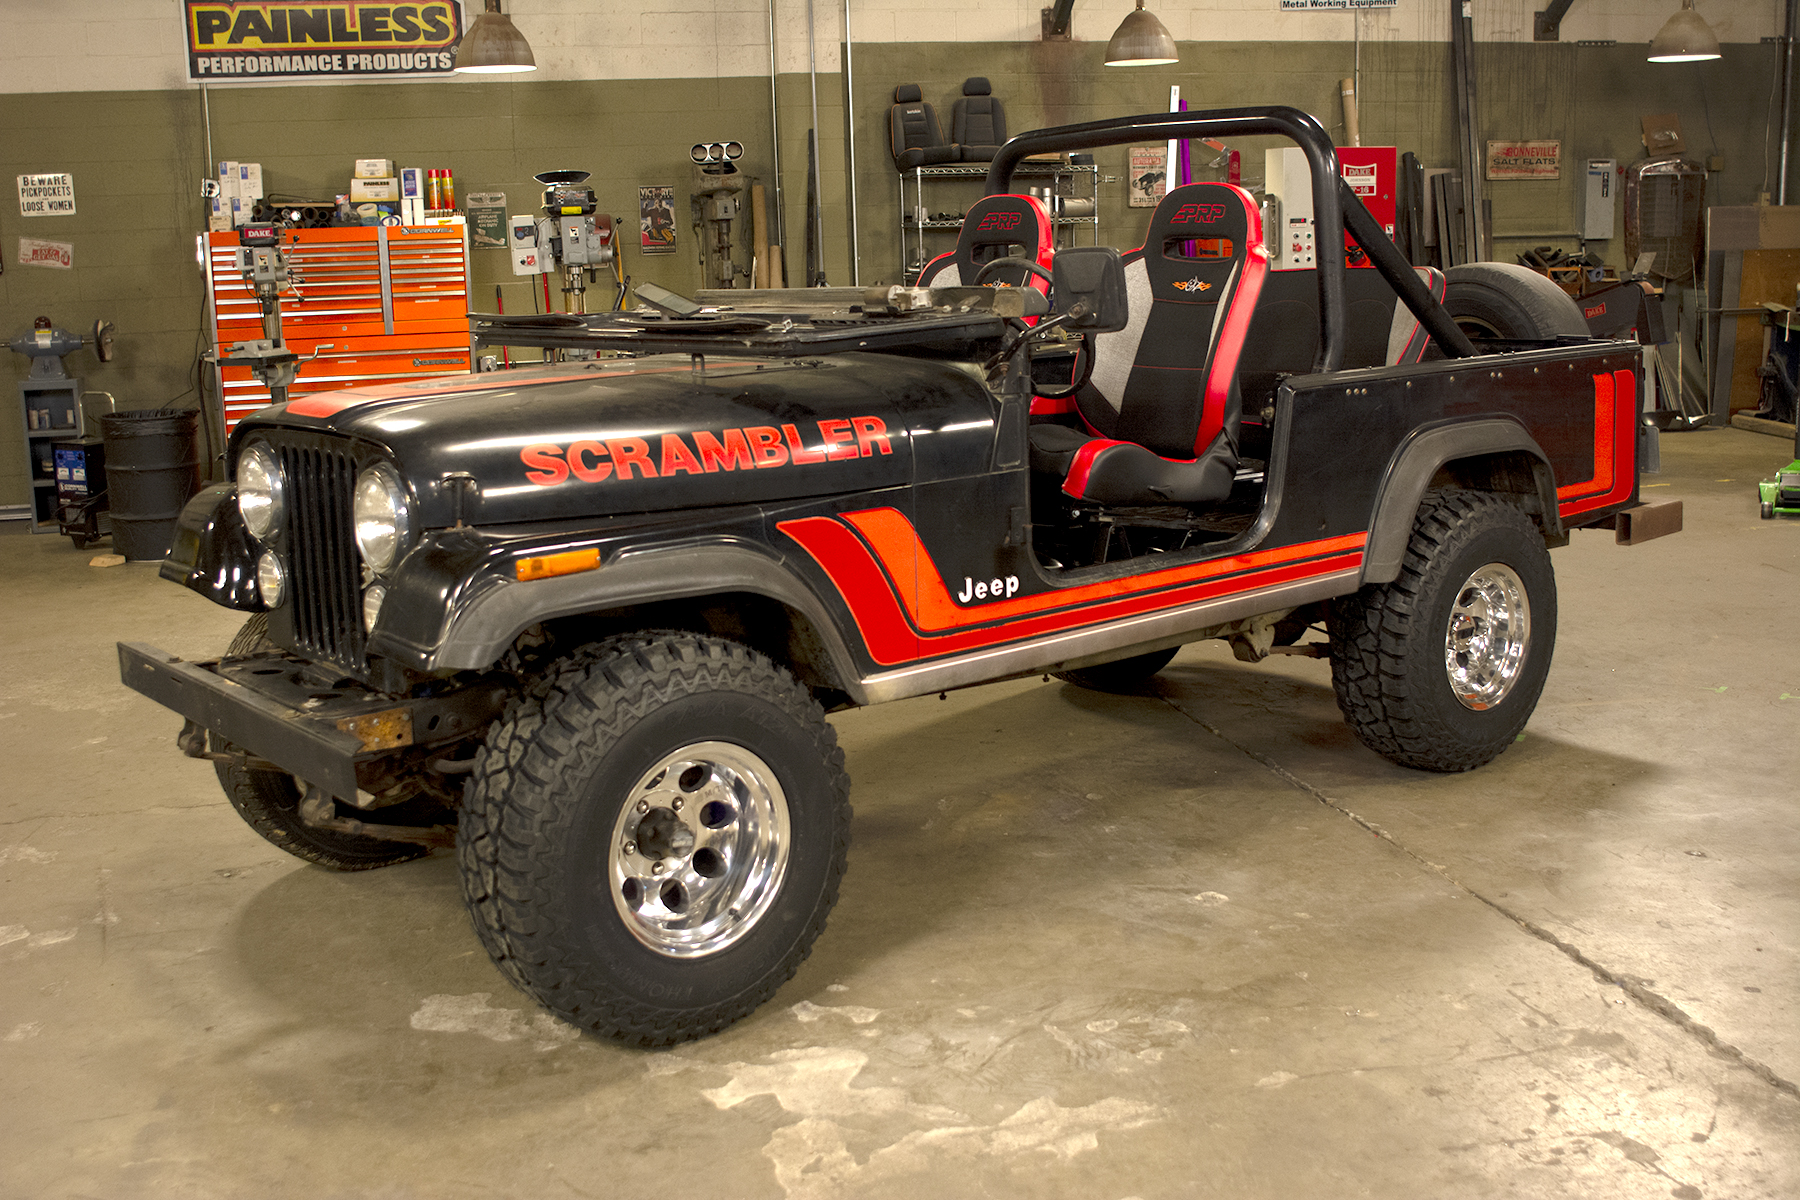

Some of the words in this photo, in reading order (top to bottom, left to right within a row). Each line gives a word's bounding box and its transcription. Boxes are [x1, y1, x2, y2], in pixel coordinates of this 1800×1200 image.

[1310, 0, 1346, 8] Working
[1350, 0, 1396, 8] Equipment
[196, 6, 451, 45] PAINLESS
[197, 55, 343, 74] PERFORMANCE
[347, 52, 453, 71] PRODUCTS
[1507, 147, 1557, 157] BONNEVILLE
[1349, 168, 1371, 176] DAKE
[23, 175, 67, 186] BEWARE
[21, 186, 71, 198] PICKPOCKETS
[22, 202, 45, 212] LOOSE
[48, 200, 74, 211] WOMEN
[1170, 204, 1226, 223] PRP
[977, 212, 1022, 230] PRP
[248, 230, 271, 238] DAKE
[520, 416, 893, 486] SCRAMBLER
[957, 575, 1020, 603] Jeep
